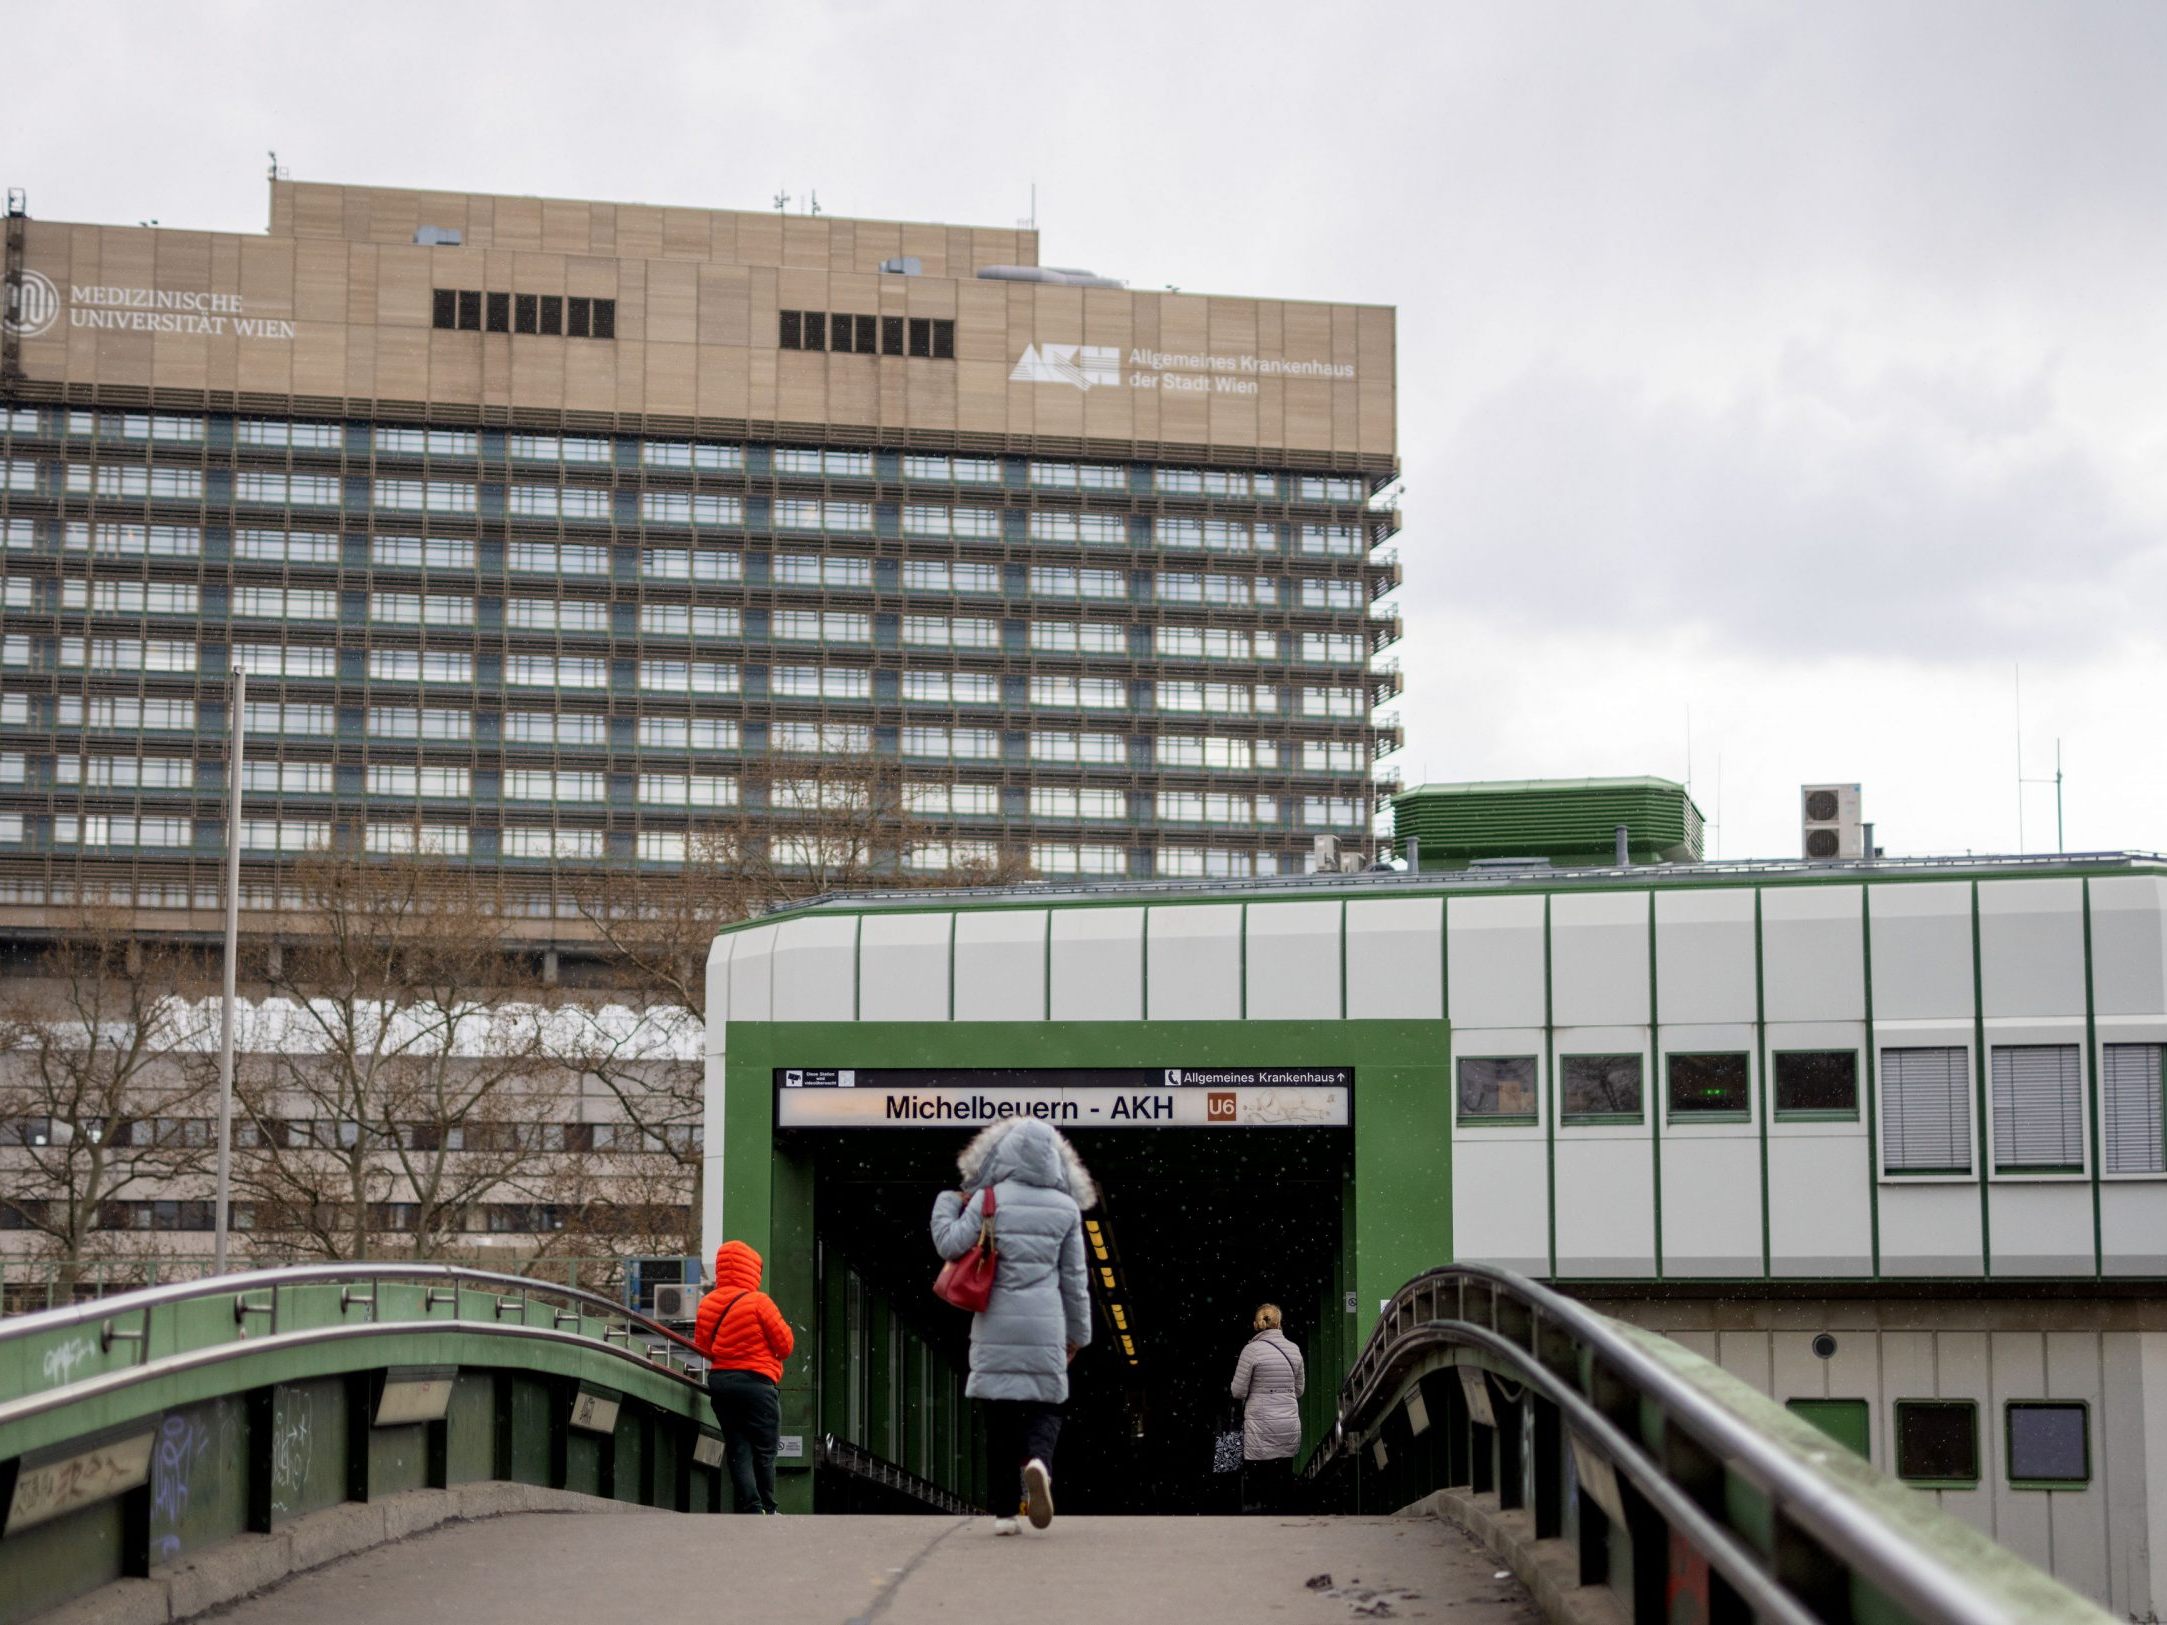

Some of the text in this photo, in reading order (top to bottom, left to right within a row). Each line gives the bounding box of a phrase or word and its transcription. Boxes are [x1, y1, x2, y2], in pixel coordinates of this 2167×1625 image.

[70, 285, 243, 312] MEDIZINISCHE
[70, 309, 297, 339] UNIVERSITÄT WIEN
[1128, 348, 1355, 378] Allgemeines Krankenhaus
[1129, 372, 1259, 394] der Stadt Wien
[1184, 1072, 1335, 1085] Allgemeines Krankenhaus
[886, 1095, 1078, 1120] Michelbeuern
[1111, 1096, 1174, 1119] AKH
[1209, 1100, 1235, 1115] U6
